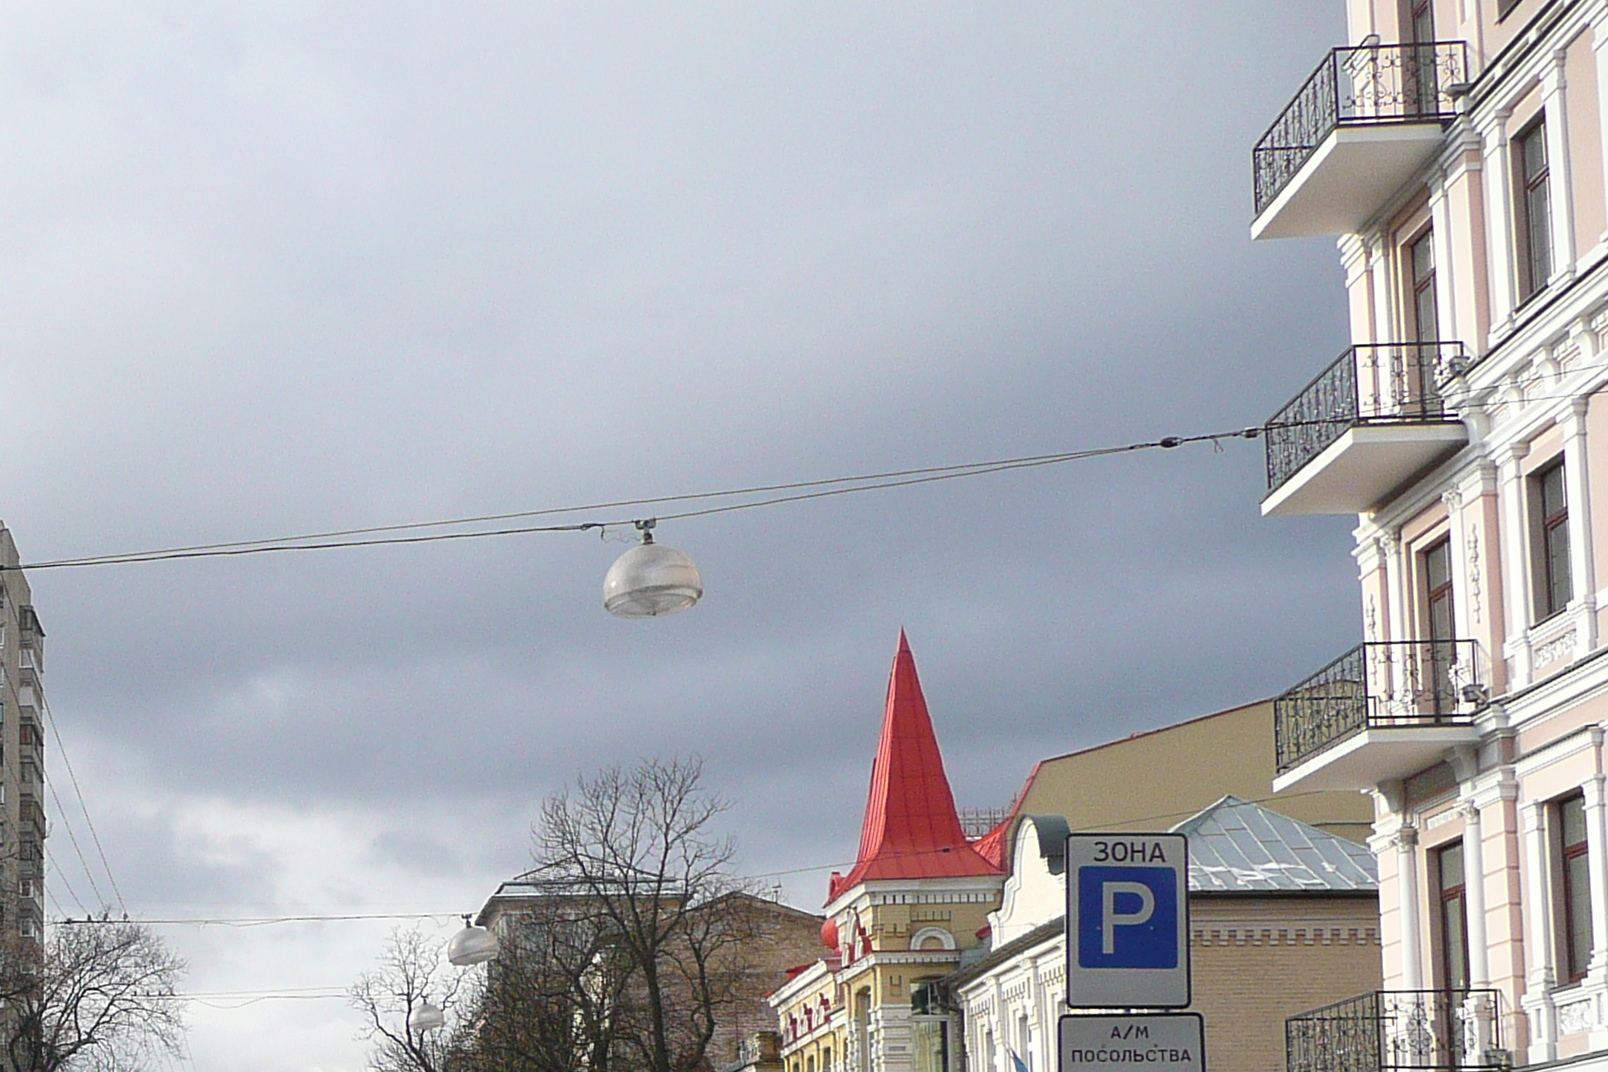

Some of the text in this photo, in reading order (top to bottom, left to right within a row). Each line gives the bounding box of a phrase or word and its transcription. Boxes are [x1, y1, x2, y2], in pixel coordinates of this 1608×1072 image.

[1093, 841, 1166, 863] ЗОНА
[1102, 881, 1155, 954] P
[1110, 1024, 1149, 1040] А/М
[1072, 1049, 1192, 1063] ПОСОЛЬСТВА
